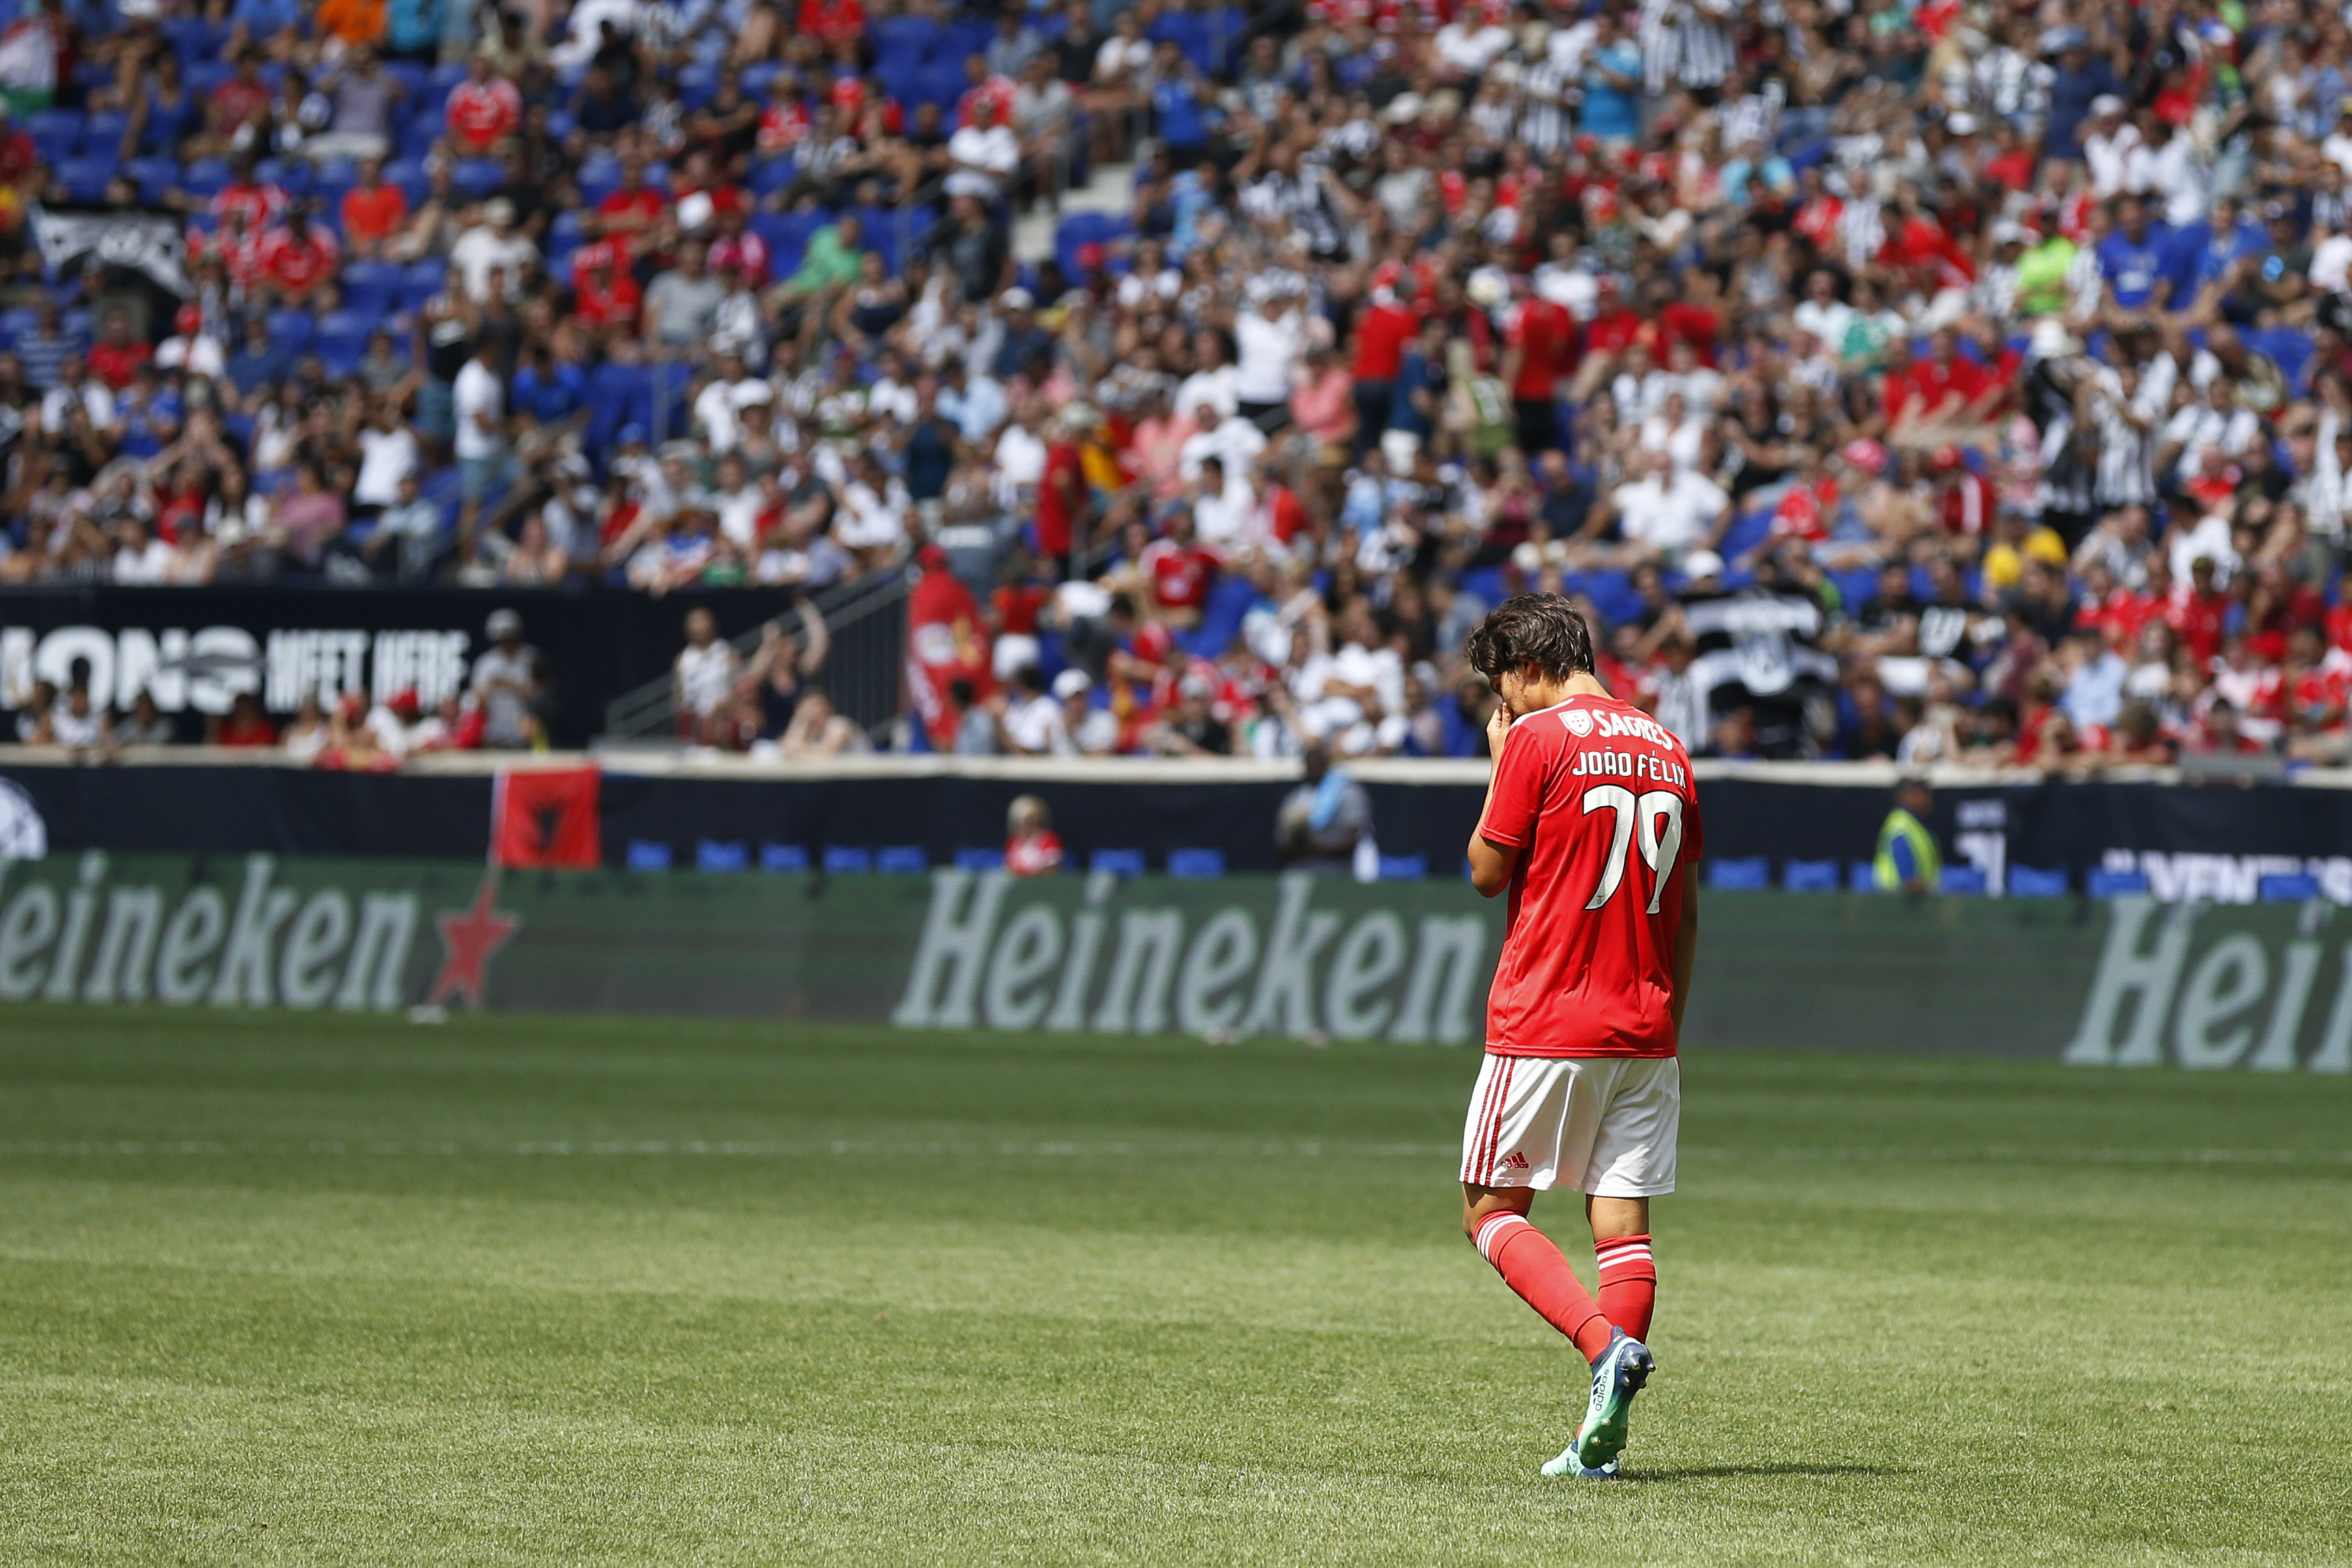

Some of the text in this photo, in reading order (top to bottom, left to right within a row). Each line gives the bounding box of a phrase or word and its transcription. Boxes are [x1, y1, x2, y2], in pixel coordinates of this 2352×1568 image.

[265, 627, 373, 714] MEET
[372, 628, 472, 715] HERE
[1572, 745, 1687, 789] JOÃO FÉLIX
[1592, 709, 1673, 751] SAGRES
[1583, 785, 1684, 915] 79
[892, 867, 1487, 1043] Heineken
